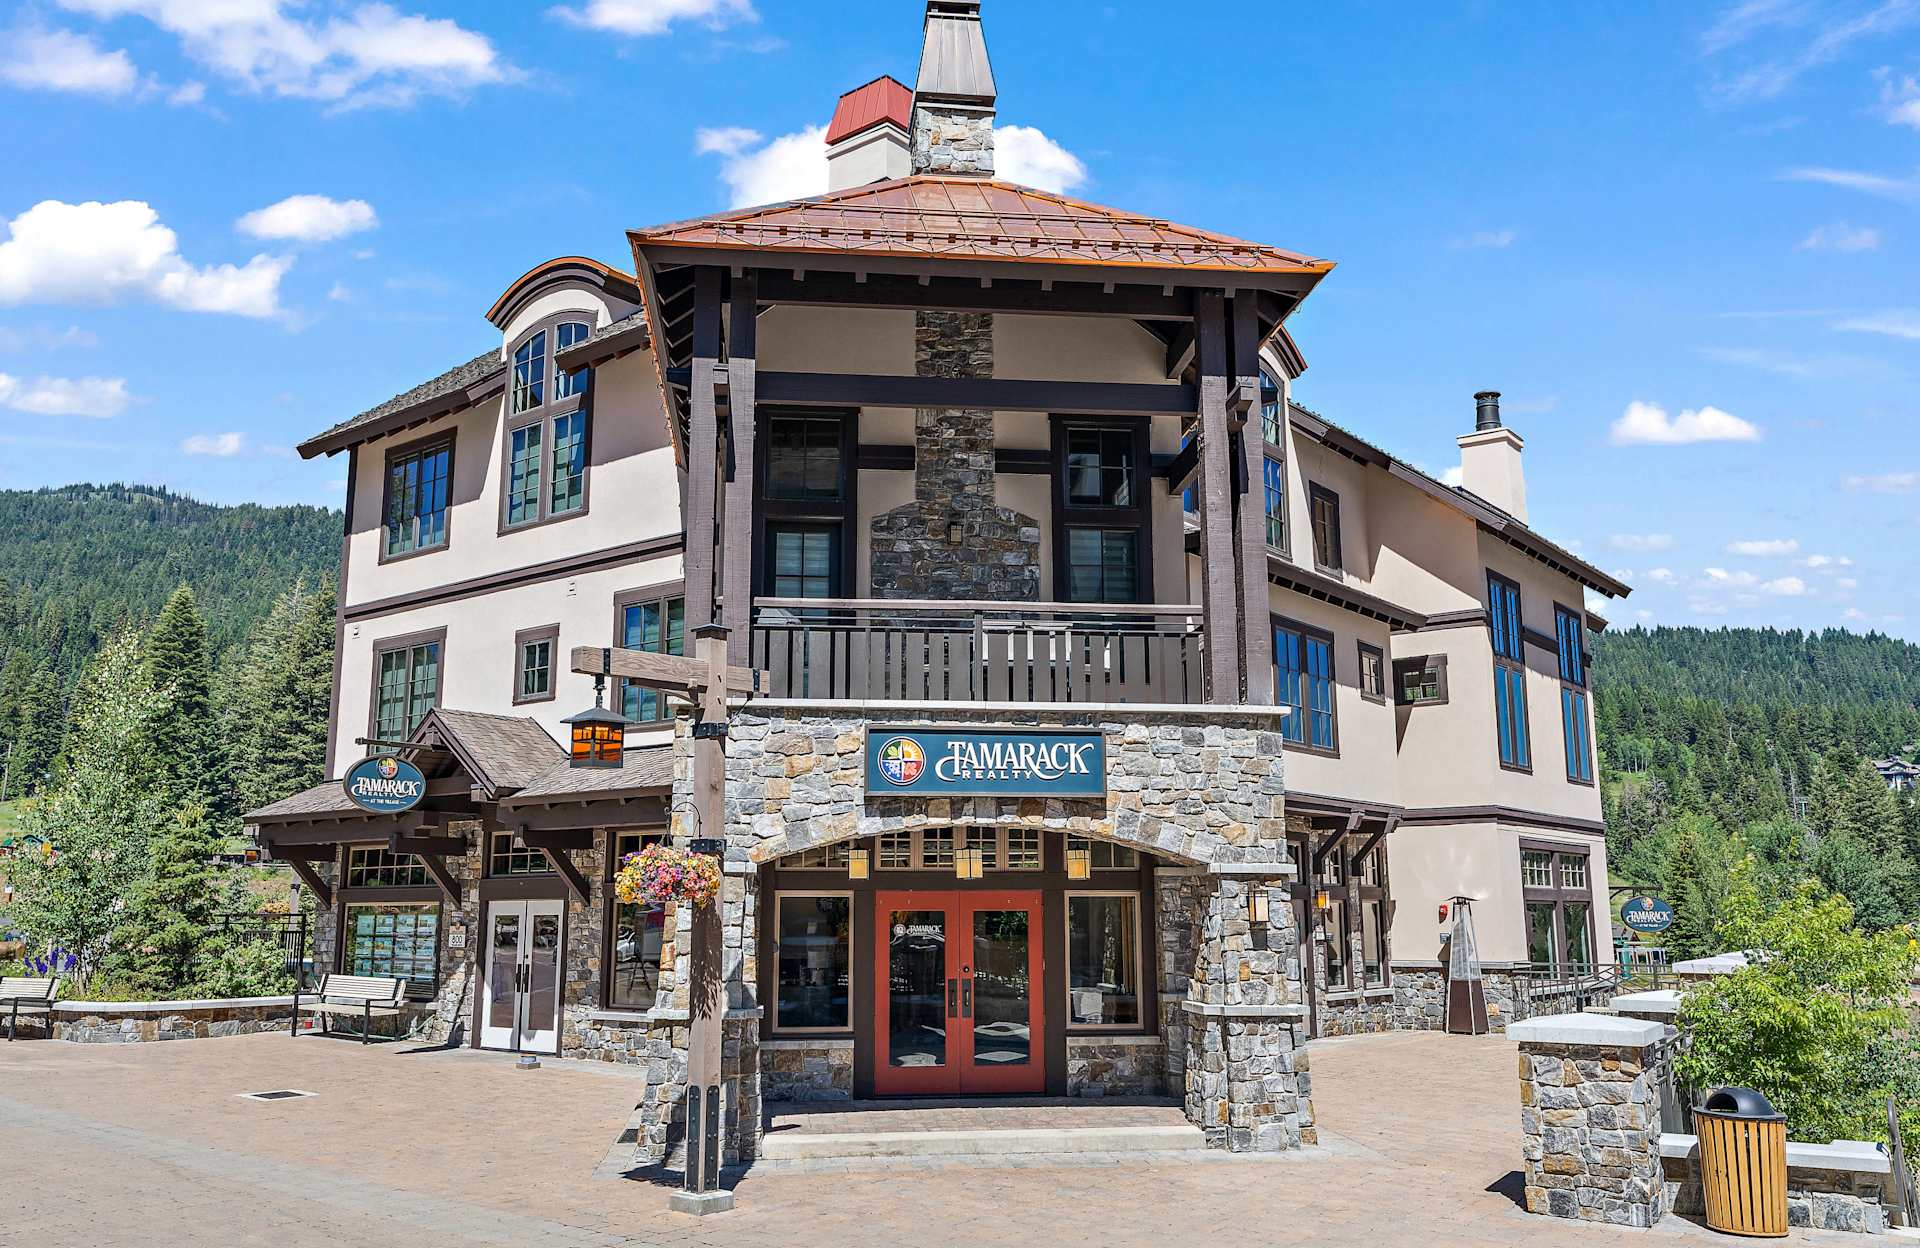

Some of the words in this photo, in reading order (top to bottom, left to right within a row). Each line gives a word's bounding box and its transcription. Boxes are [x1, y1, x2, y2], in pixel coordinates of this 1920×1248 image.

[934, 741, 1095, 781] TAMARACK
[962, 771, 1034, 780] REALTY
[350, 776, 421, 798] TAMARACK
[362, 790, 395, 798] REALTY
[1626, 910, 1671, 923] TAMARACK
[906, 924, 942, 935] TAMARACK
